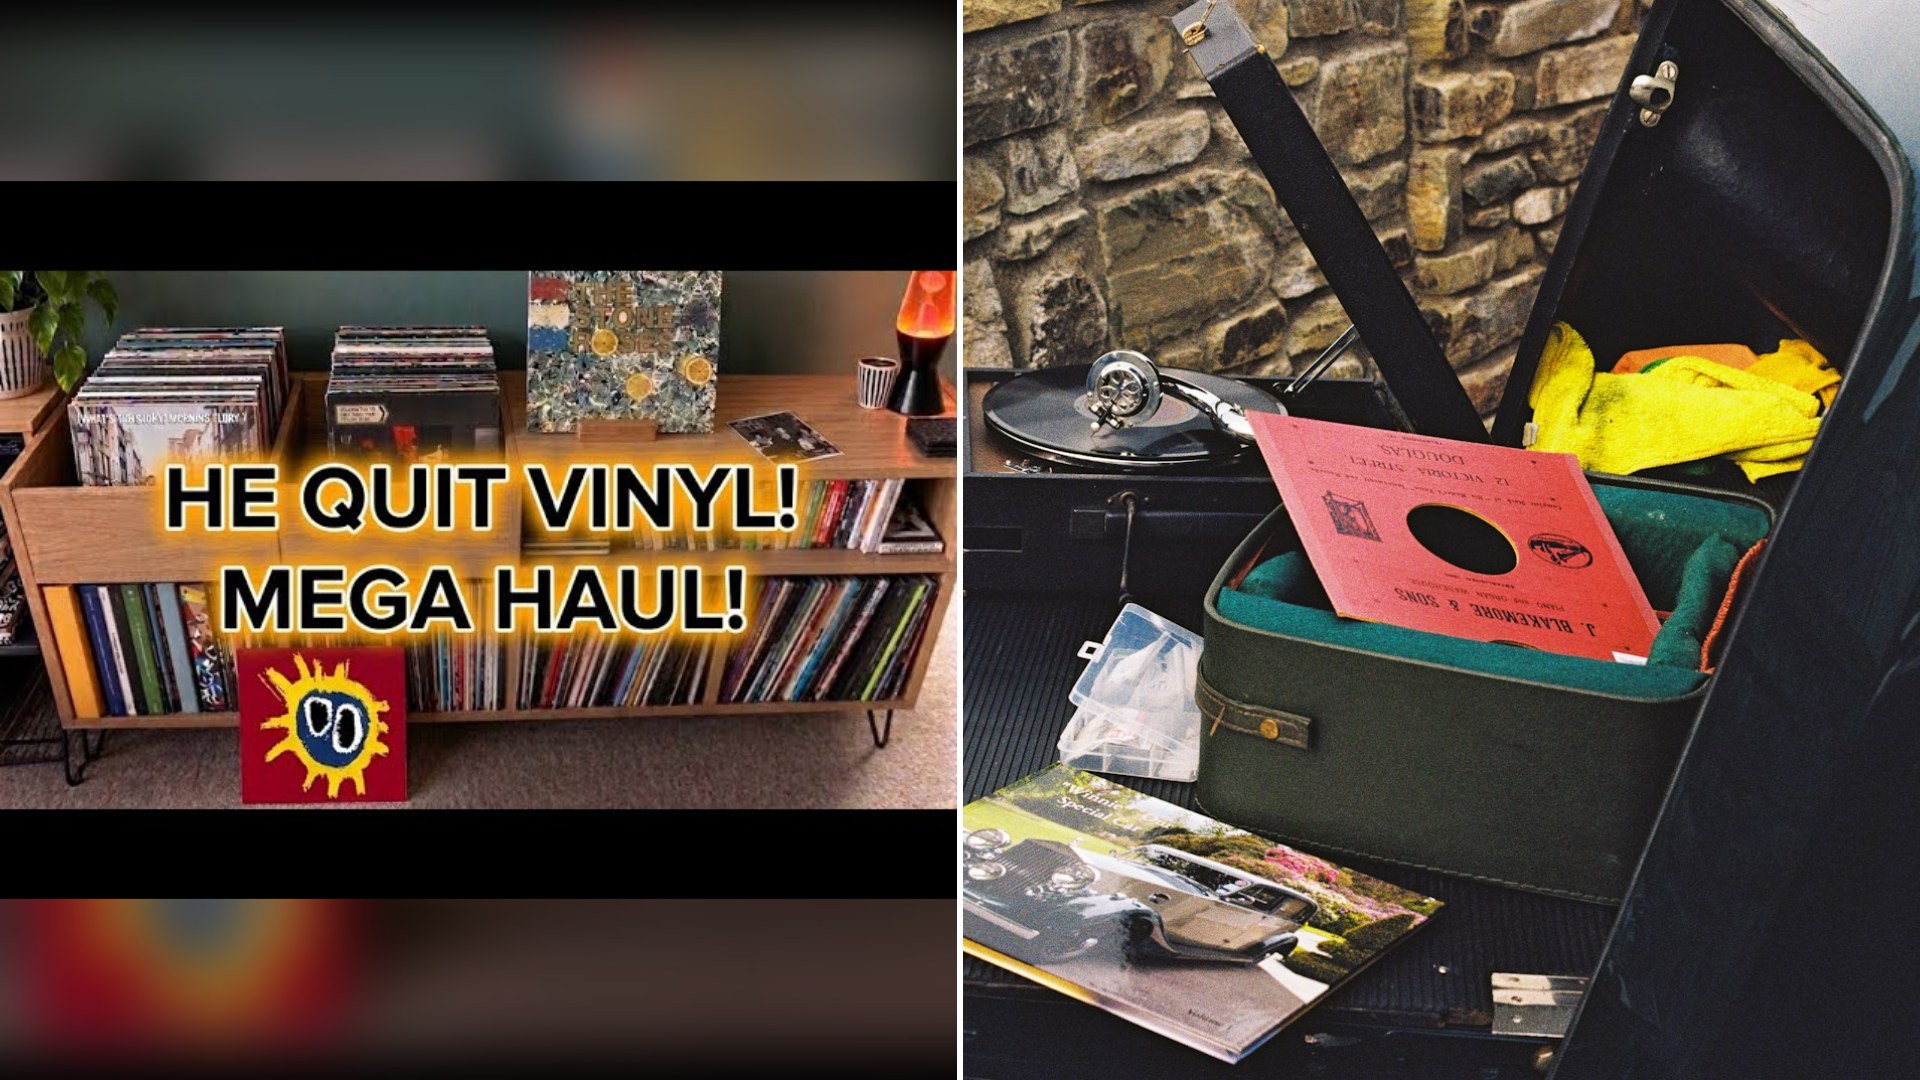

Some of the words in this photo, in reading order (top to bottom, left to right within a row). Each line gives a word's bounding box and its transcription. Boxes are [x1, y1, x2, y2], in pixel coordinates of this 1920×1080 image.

[575, 281, 633, 307] THE
[576, 306, 674, 329] STONE
[573, 331, 674, 354] RSES
[1416, 466, 1485, 484] VICTORIA
[1494, 476, 1510, 488] 12
[1392, 586, 1440, 609] SONS
[1448, 599, 1461, 613] &
[1475, 590, 1508, 603] ORGAN
[1535, 601, 1566, 613] PIANO
[1469, 603, 1575, 635] BLAKEMORE
[1580, 622, 1597, 638] J.
[1057, 795, 1114, 821] Special
[1112, 816, 1142, 833] Car
